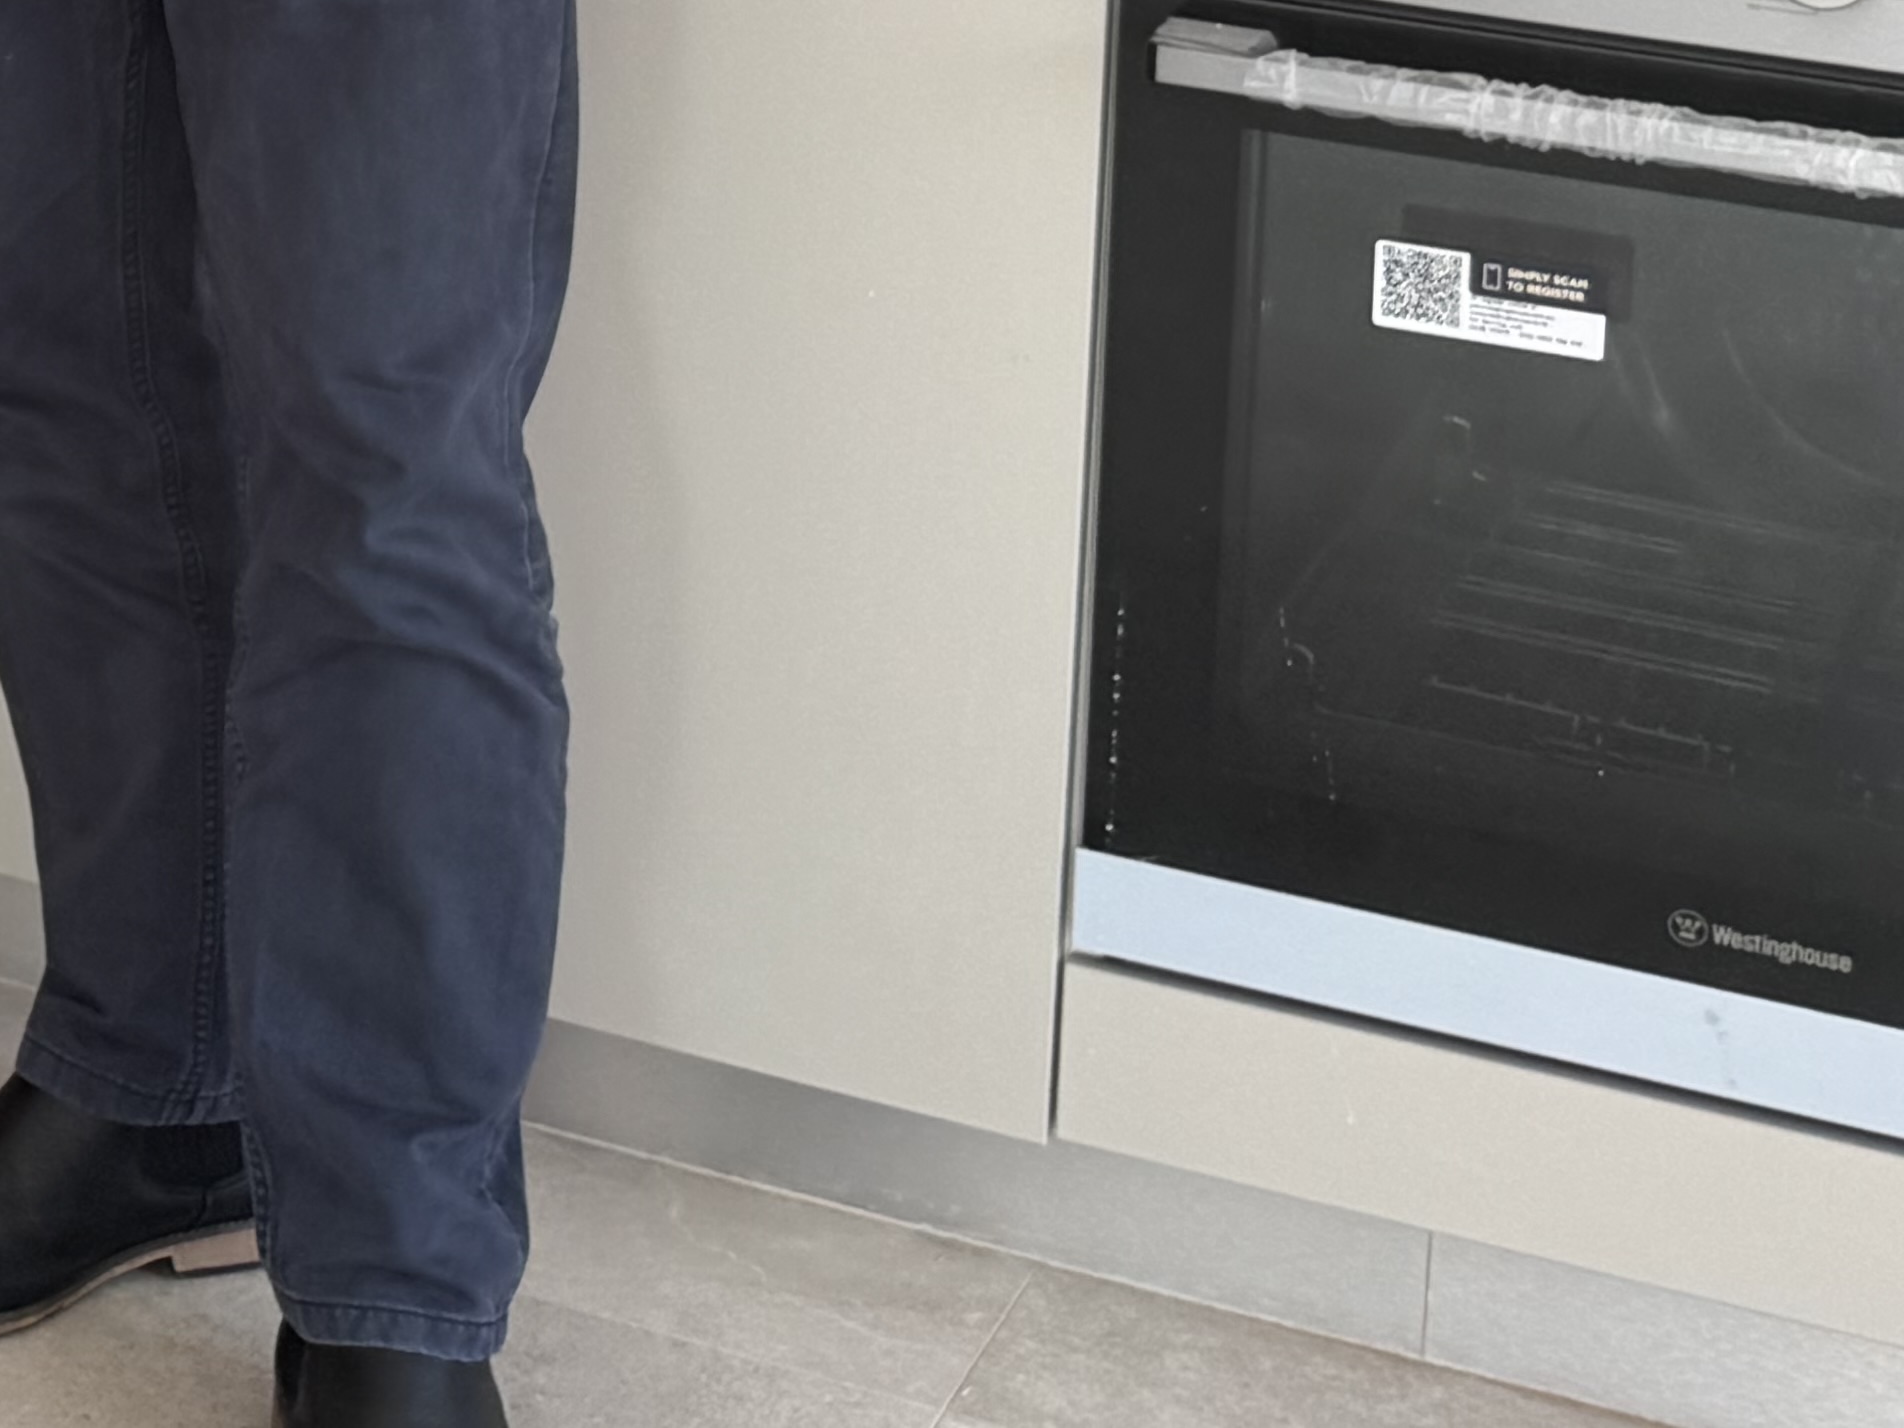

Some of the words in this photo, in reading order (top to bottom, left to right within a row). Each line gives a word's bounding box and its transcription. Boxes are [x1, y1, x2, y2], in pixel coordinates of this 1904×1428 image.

[1507, 267, 1551, 282] SIMPLY
[1553, 273, 1589, 289] SCAN
[1506, 280, 1524, 292] TO
[1526, 283, 1585, 302] REGISTER
[1711, 923, 1853, 974] Westinghouse
